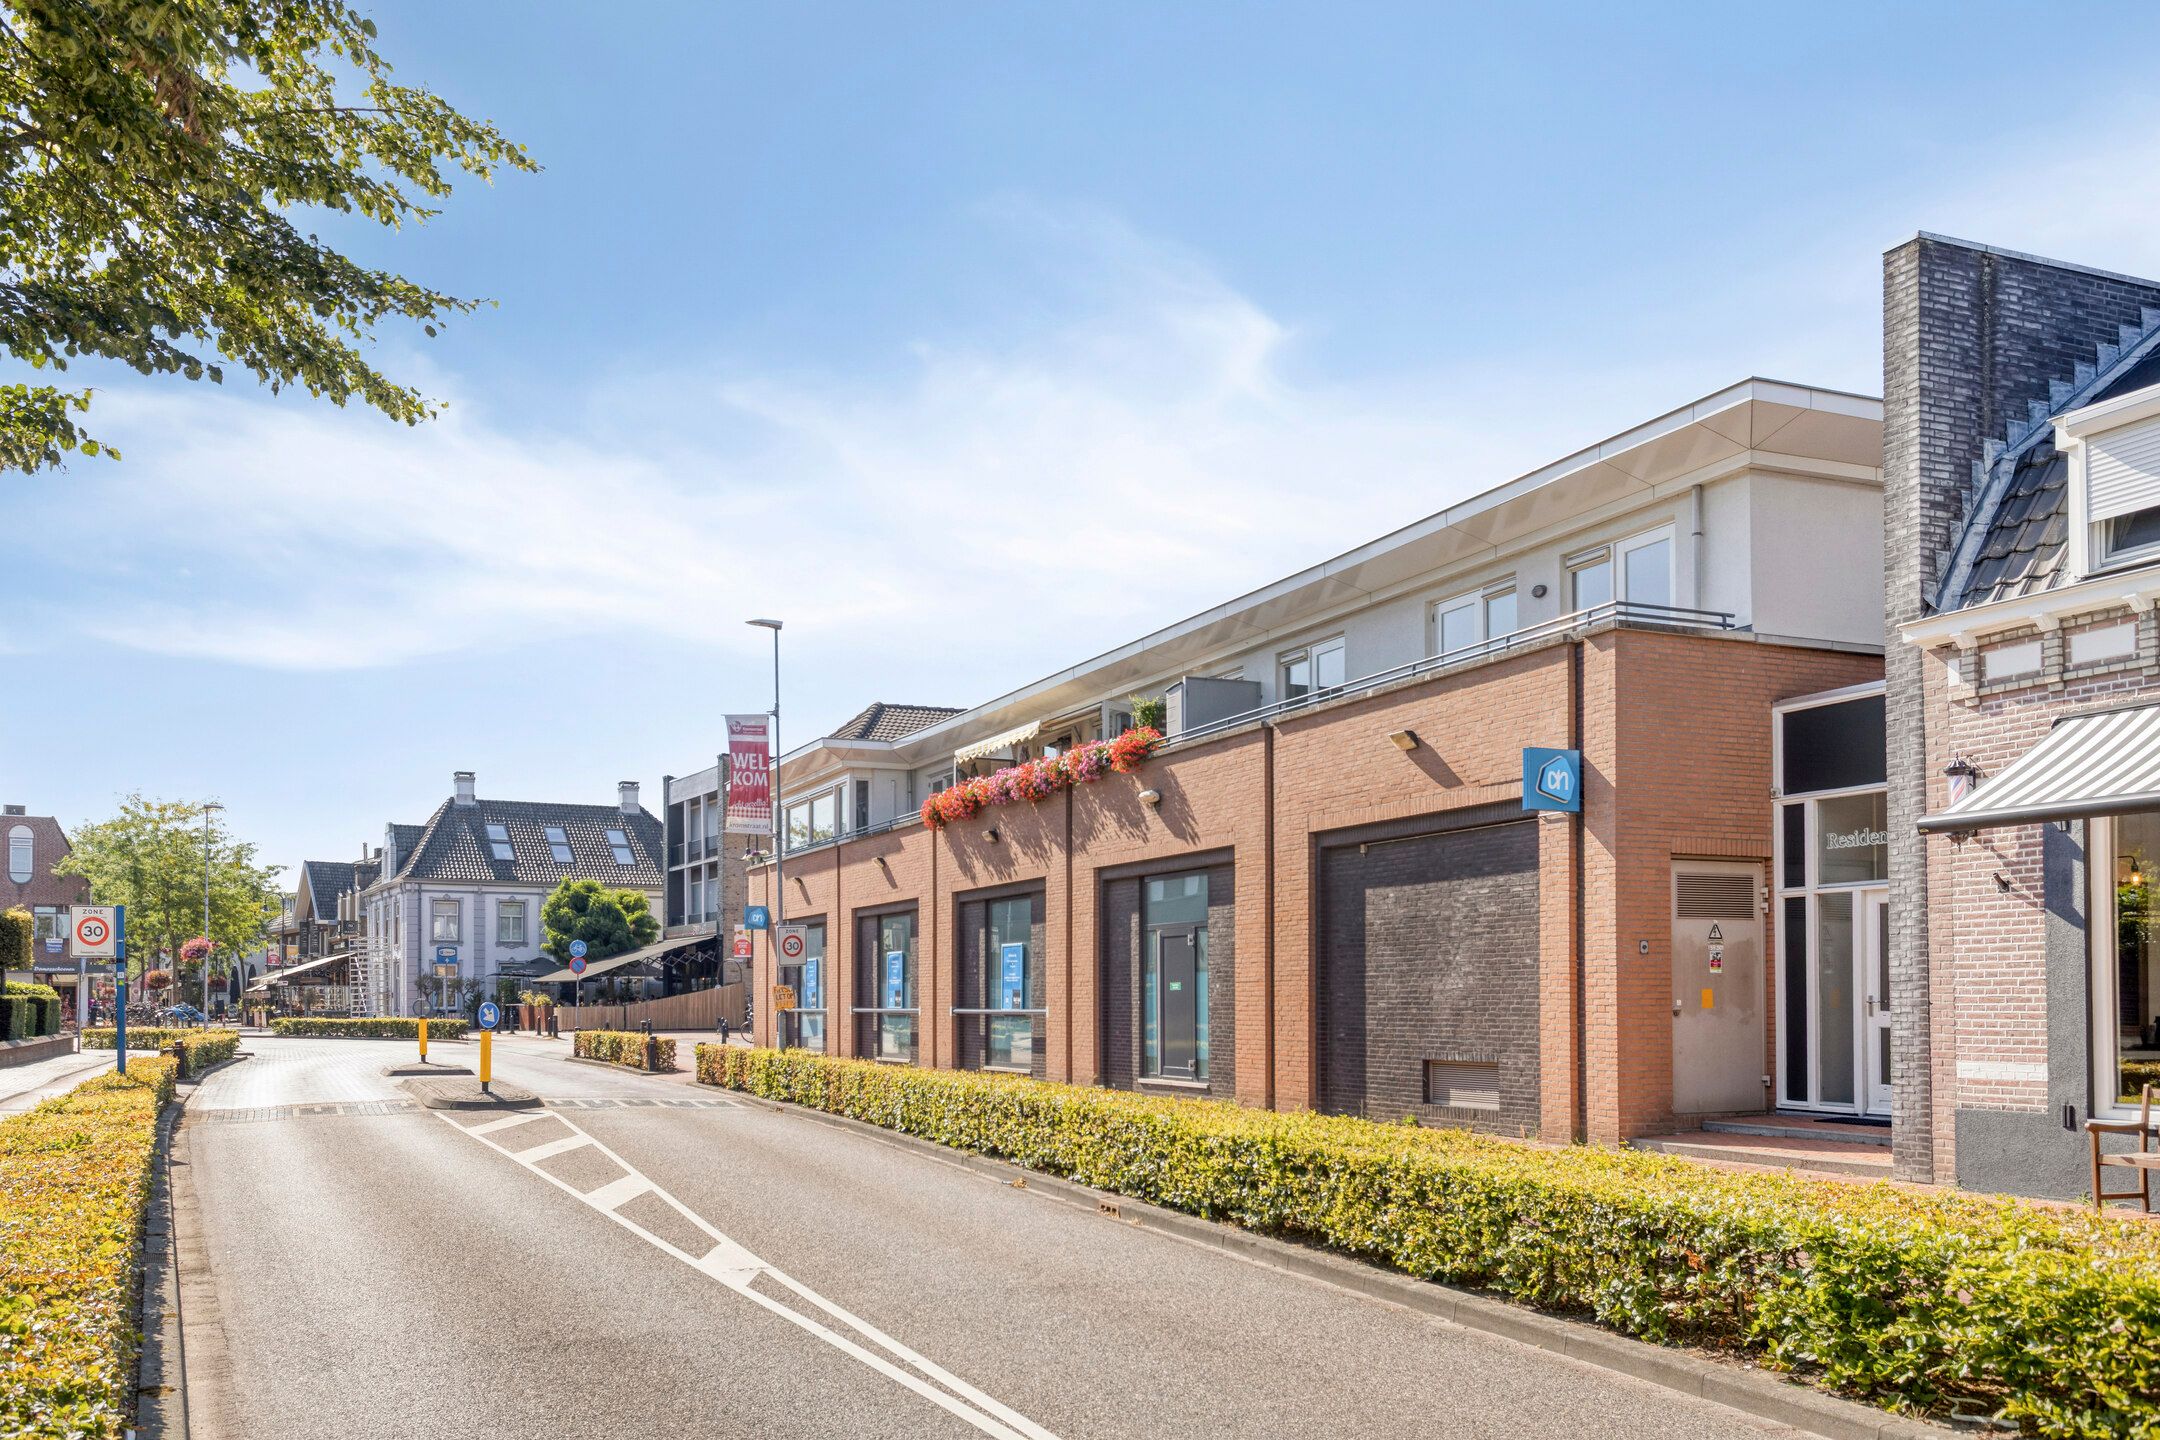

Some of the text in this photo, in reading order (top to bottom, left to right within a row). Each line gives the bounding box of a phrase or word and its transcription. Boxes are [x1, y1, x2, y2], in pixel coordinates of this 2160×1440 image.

[731, 752, 768, 770] WEL
[732, 771, 768, 787] KOM
[1826, 827, 1889, 850] Residen
[83, 925, 104, 937] 30
[786, 941, 800, 951] 30
